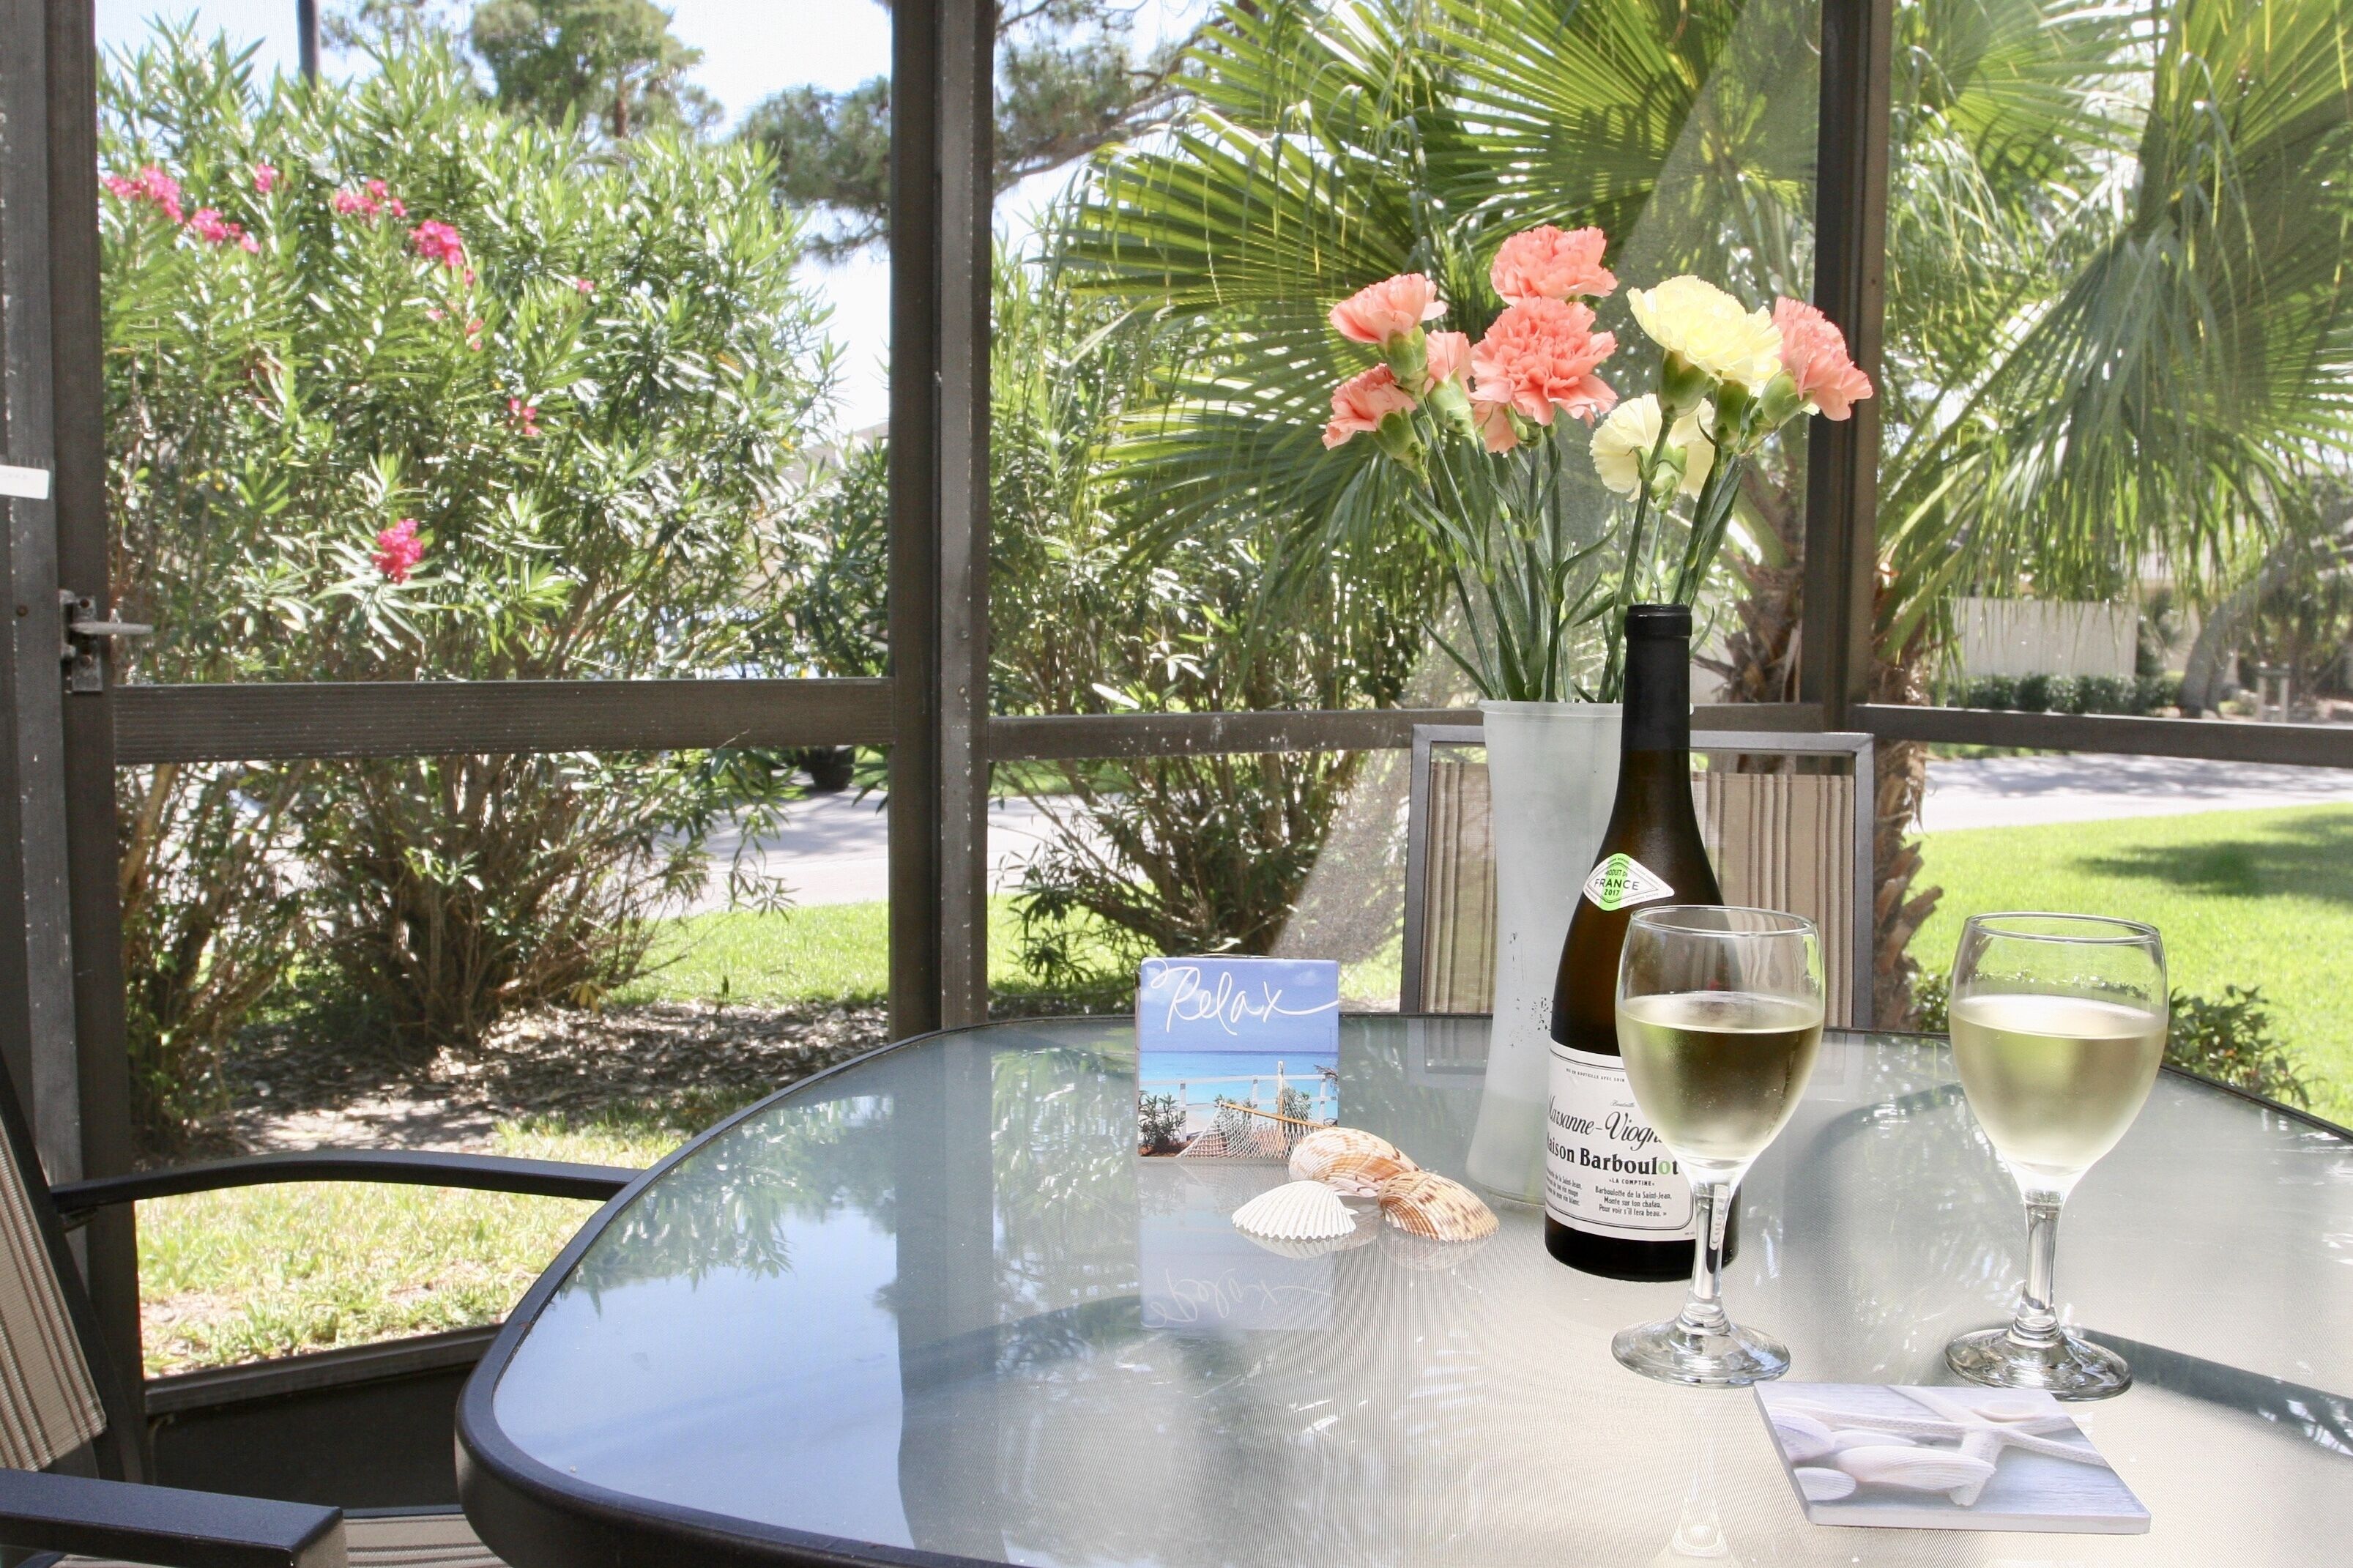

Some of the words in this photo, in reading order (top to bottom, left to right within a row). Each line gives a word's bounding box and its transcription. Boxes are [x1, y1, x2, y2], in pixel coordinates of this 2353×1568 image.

[1594, 878, 1640, 891] FRANCE
[1141, 958, 1338, 1036] Relax
[1580, 1148, 1679, 1175] Barboulot
[1627, 1189, 1634, 1198] de
[1635, 1190, 1641, 1199] la
